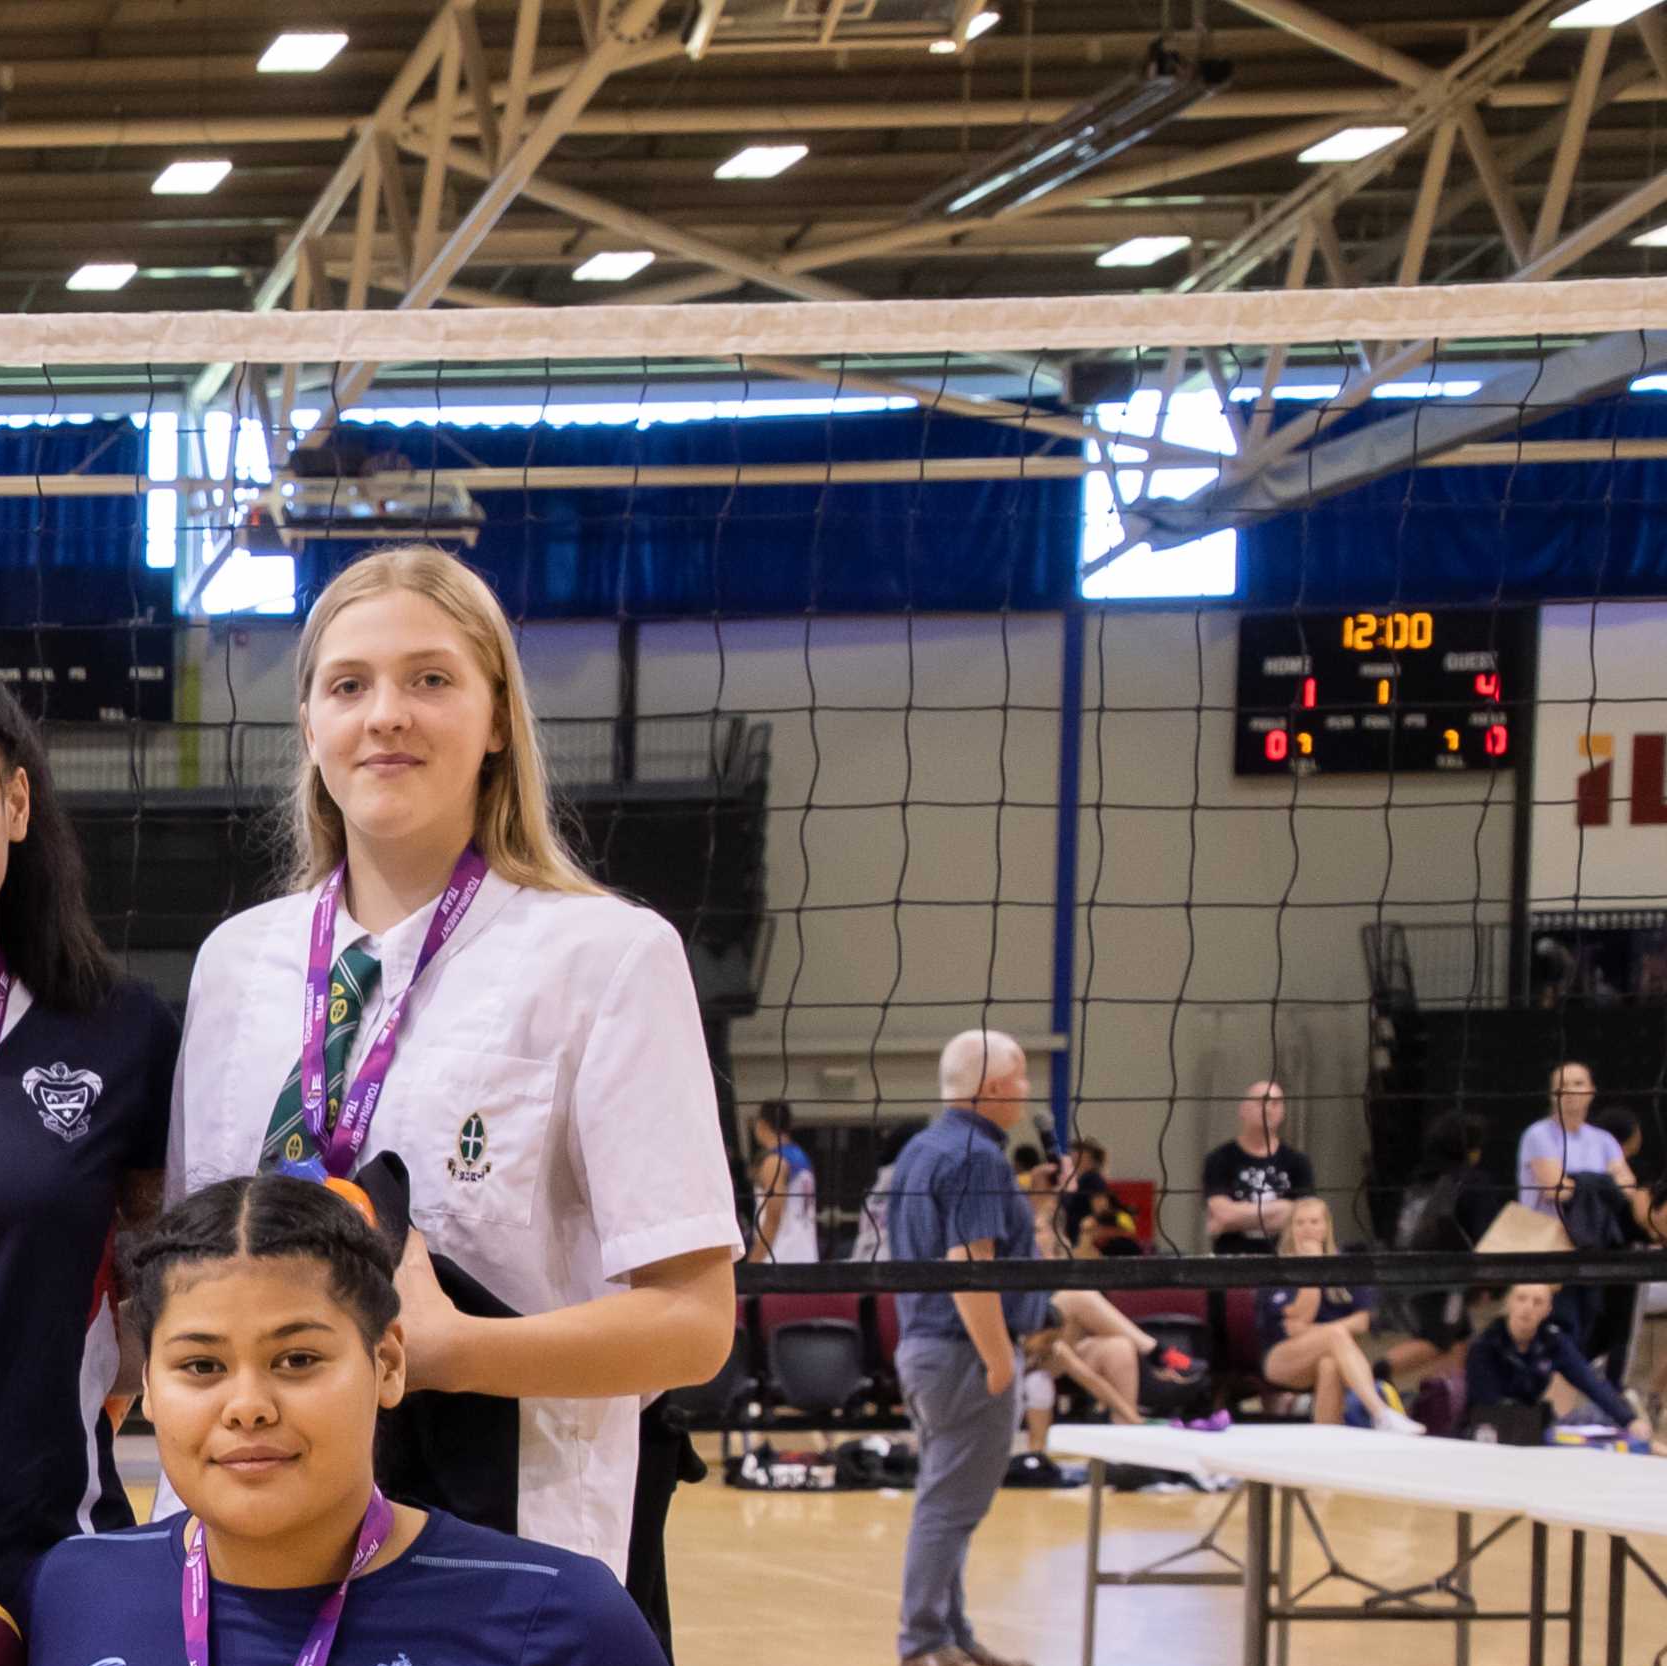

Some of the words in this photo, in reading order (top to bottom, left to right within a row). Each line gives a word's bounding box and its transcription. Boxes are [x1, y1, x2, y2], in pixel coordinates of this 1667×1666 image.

[1342, 612, 1433, 650] 12:00
[1264, 729, 1288, 762] 0
[437, 887, 459, 915] TEAM
[316, 994, 325, 1021] TEAM
[343, 1101, 359, 1129] TEAM
[350, 1082, 379, 1153] TOURNAMENT
